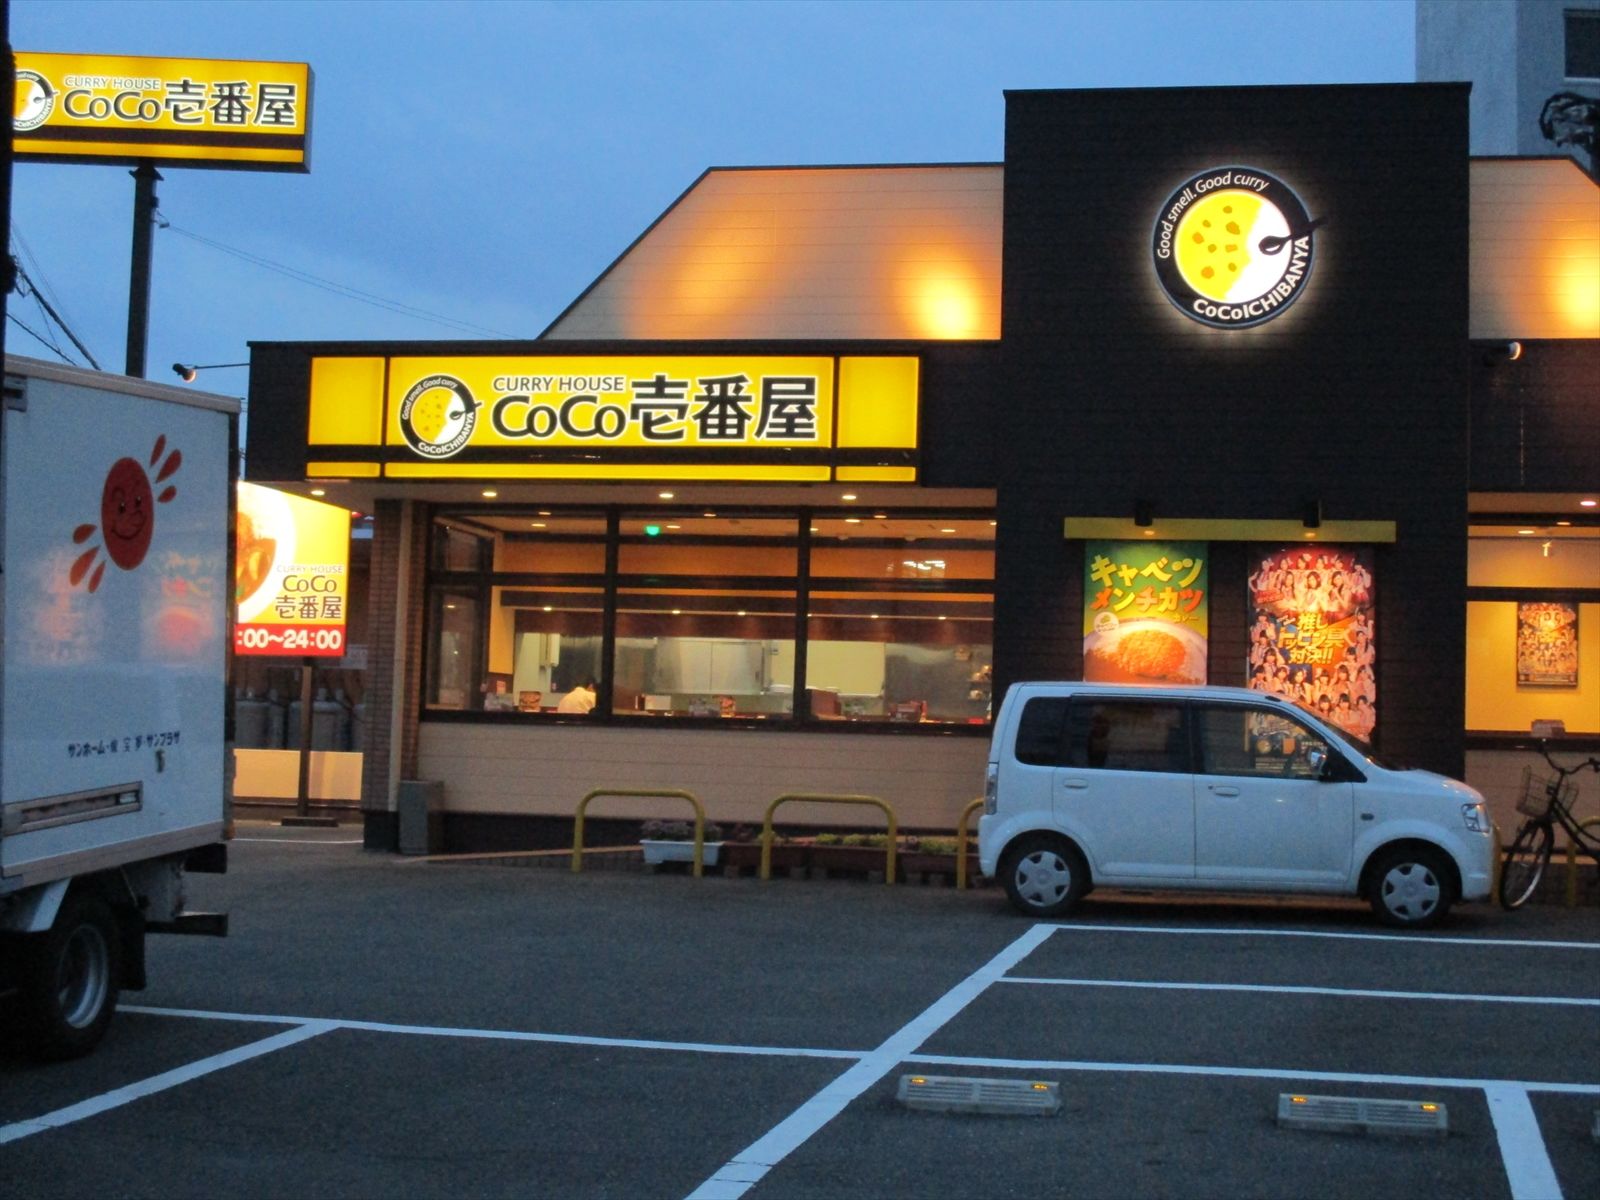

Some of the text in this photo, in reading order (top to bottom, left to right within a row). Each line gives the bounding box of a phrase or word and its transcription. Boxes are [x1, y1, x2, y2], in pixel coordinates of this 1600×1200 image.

[65, 76, 160, 90] CURRY HOUSE
[63, 80, 296, 126] CoCo壱番屋
[1157, 171, 1270, 259] Good smell. Good curry
[1193, 236, 1310, 321] CoCoICHIBANYA
[423, 378, 441, 389] Good
[494, 376, 624, 392] CURRY HOUSE
[492, 375, 817, 440] CoCo壱番屋
[310, 565, 343, 574] HOUSE
[1090, 554, 1204, 588] キャベツ
[282, 574, 337, 593] CoCo
[275, 594, 342, 619] 壱番屋
[1090, 585, 1204, 613] メンチカツ
